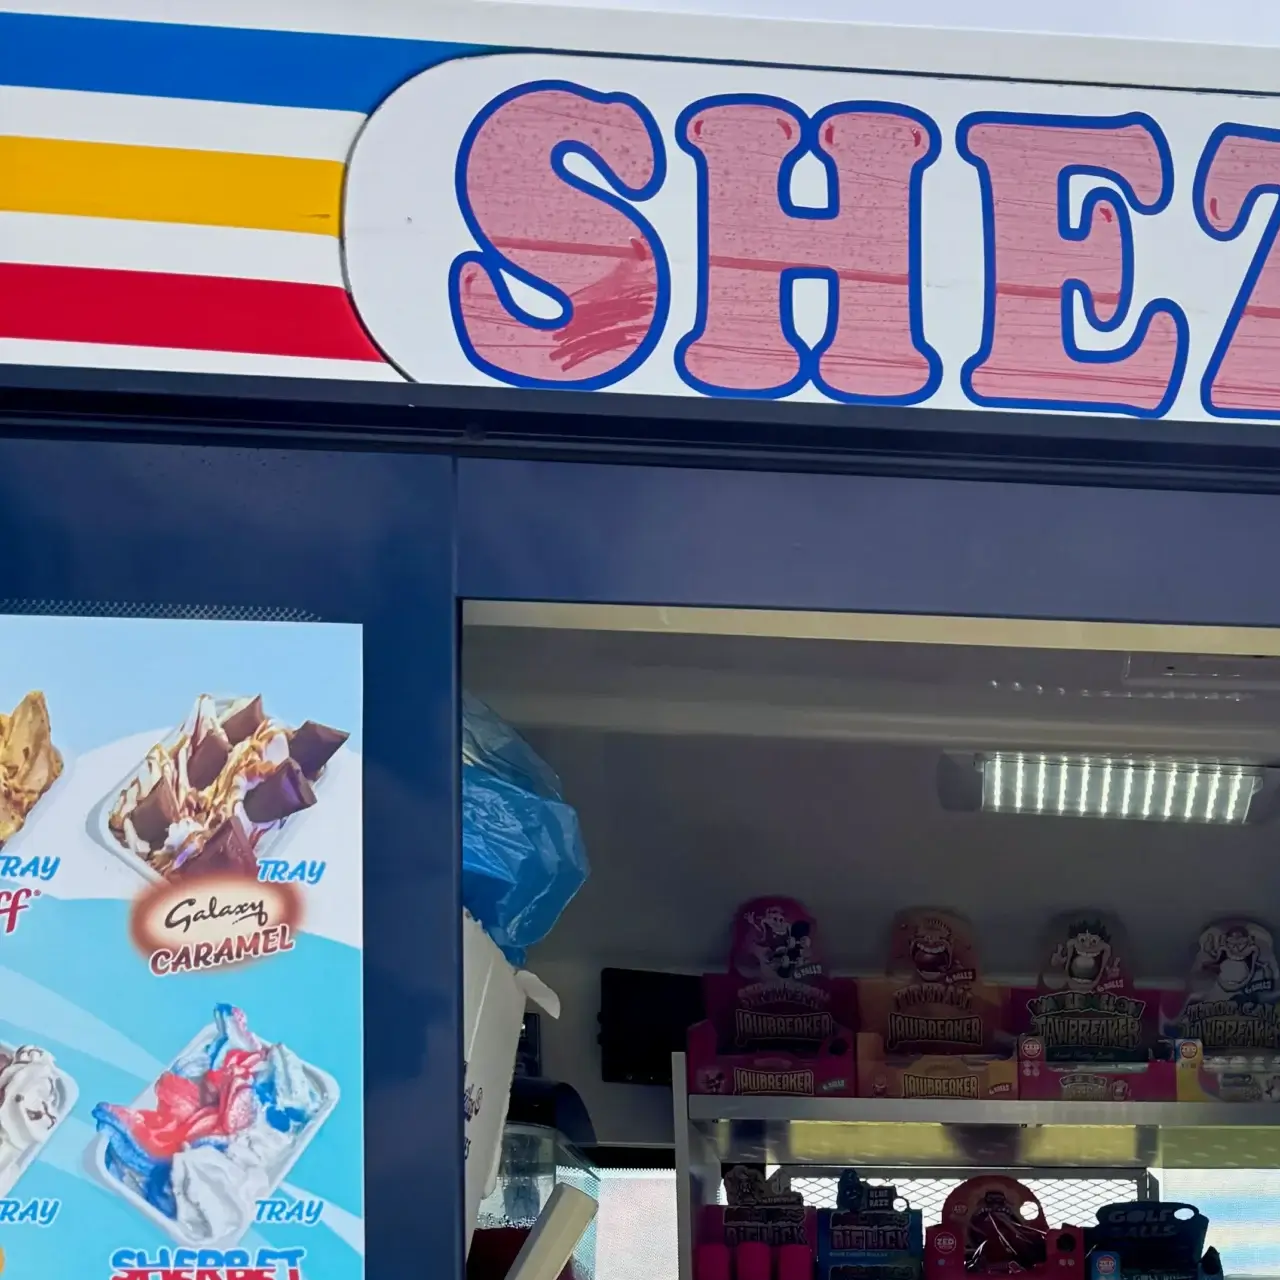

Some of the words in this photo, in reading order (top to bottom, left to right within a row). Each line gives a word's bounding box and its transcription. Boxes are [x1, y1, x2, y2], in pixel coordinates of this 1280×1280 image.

[256, 860, 326, 885] TRAY
[164, 896, 269, 933] Galaxy
[151, 925, 294, 976] CARAMEL
[734, 1009, 832, 1047] JAWBREAKER
[887, 1013, 983, 1049] JAWBREAKER
[1031, 1015, 1142, 1050] JAWBREAKER
[734, 1067, 814, 1095] JAWBREAKER
[903, 1073, 980, 1099] JAWBREAKER
[0, 1200, 60, 1224] RAY
[255, 1200, 324, 1224] TRAY
[1108, 1209, 1174, 1223] GOLF
